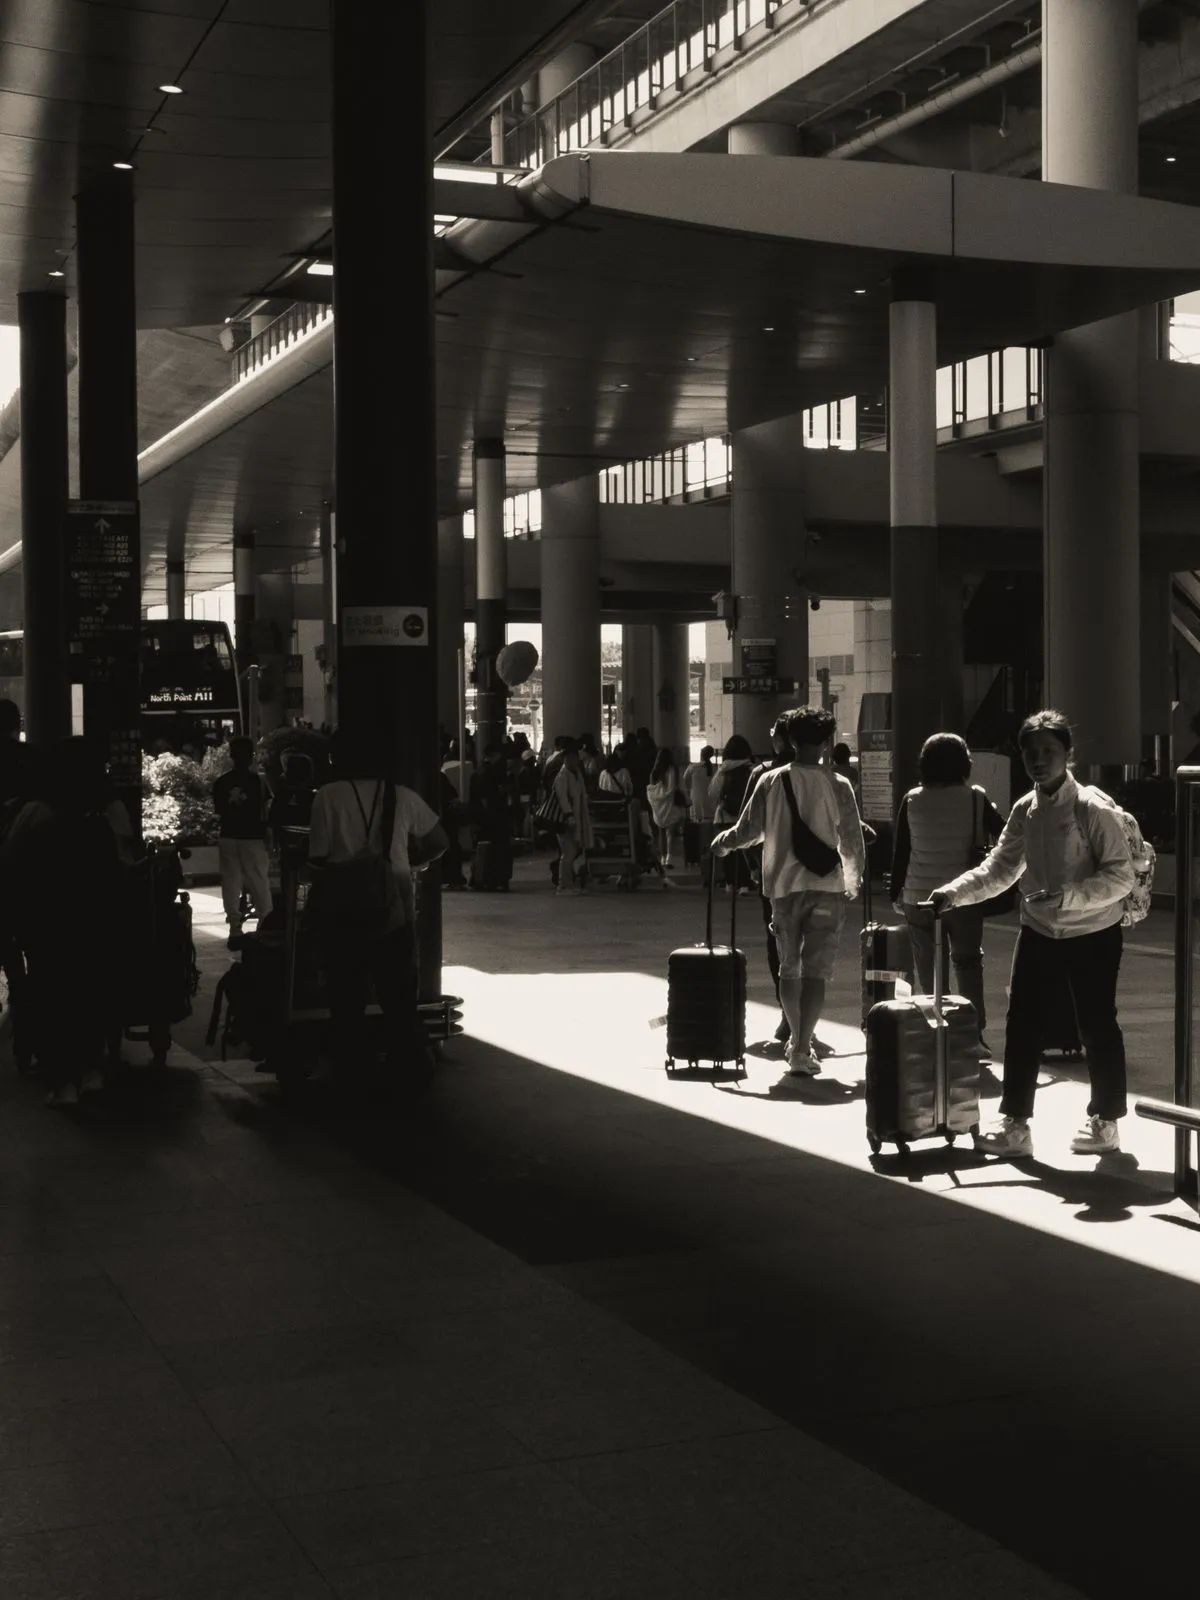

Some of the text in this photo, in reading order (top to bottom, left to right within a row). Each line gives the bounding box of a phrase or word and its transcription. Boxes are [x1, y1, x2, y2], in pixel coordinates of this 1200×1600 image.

[150, 691, 213, 703] North Point A11
